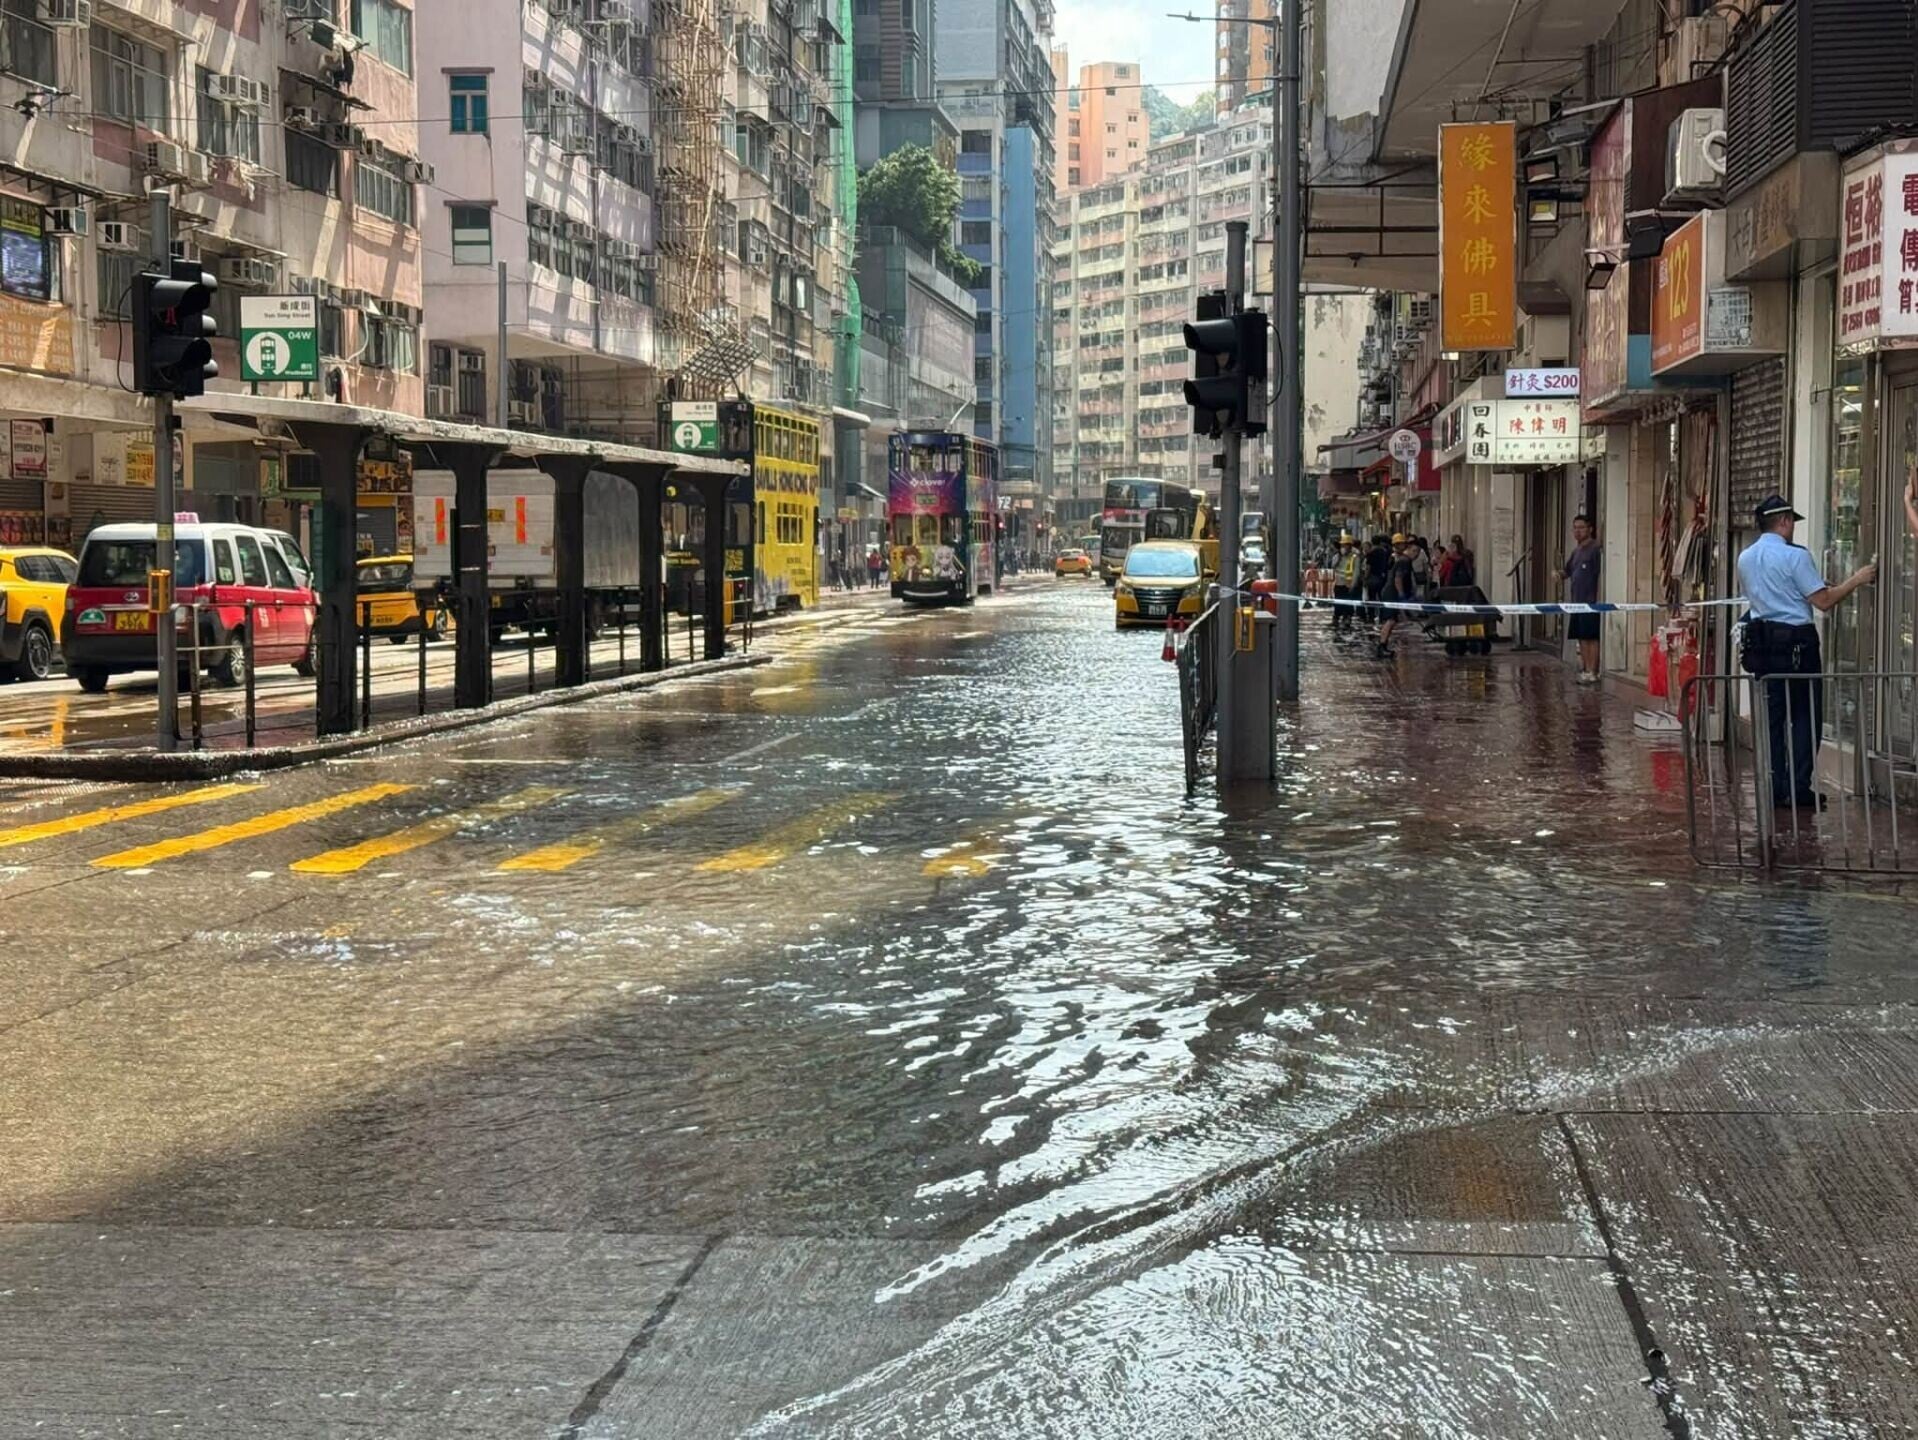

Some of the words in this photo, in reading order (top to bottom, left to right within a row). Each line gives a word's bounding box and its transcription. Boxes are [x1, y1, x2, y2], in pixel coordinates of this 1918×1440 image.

[1669, 239, 1690, 322] 123
[287, 331, 312, 340] 04W
[1508, 373, 1543, 392] 針灸
[1509, 416, 1568, 434] 陳偉明
